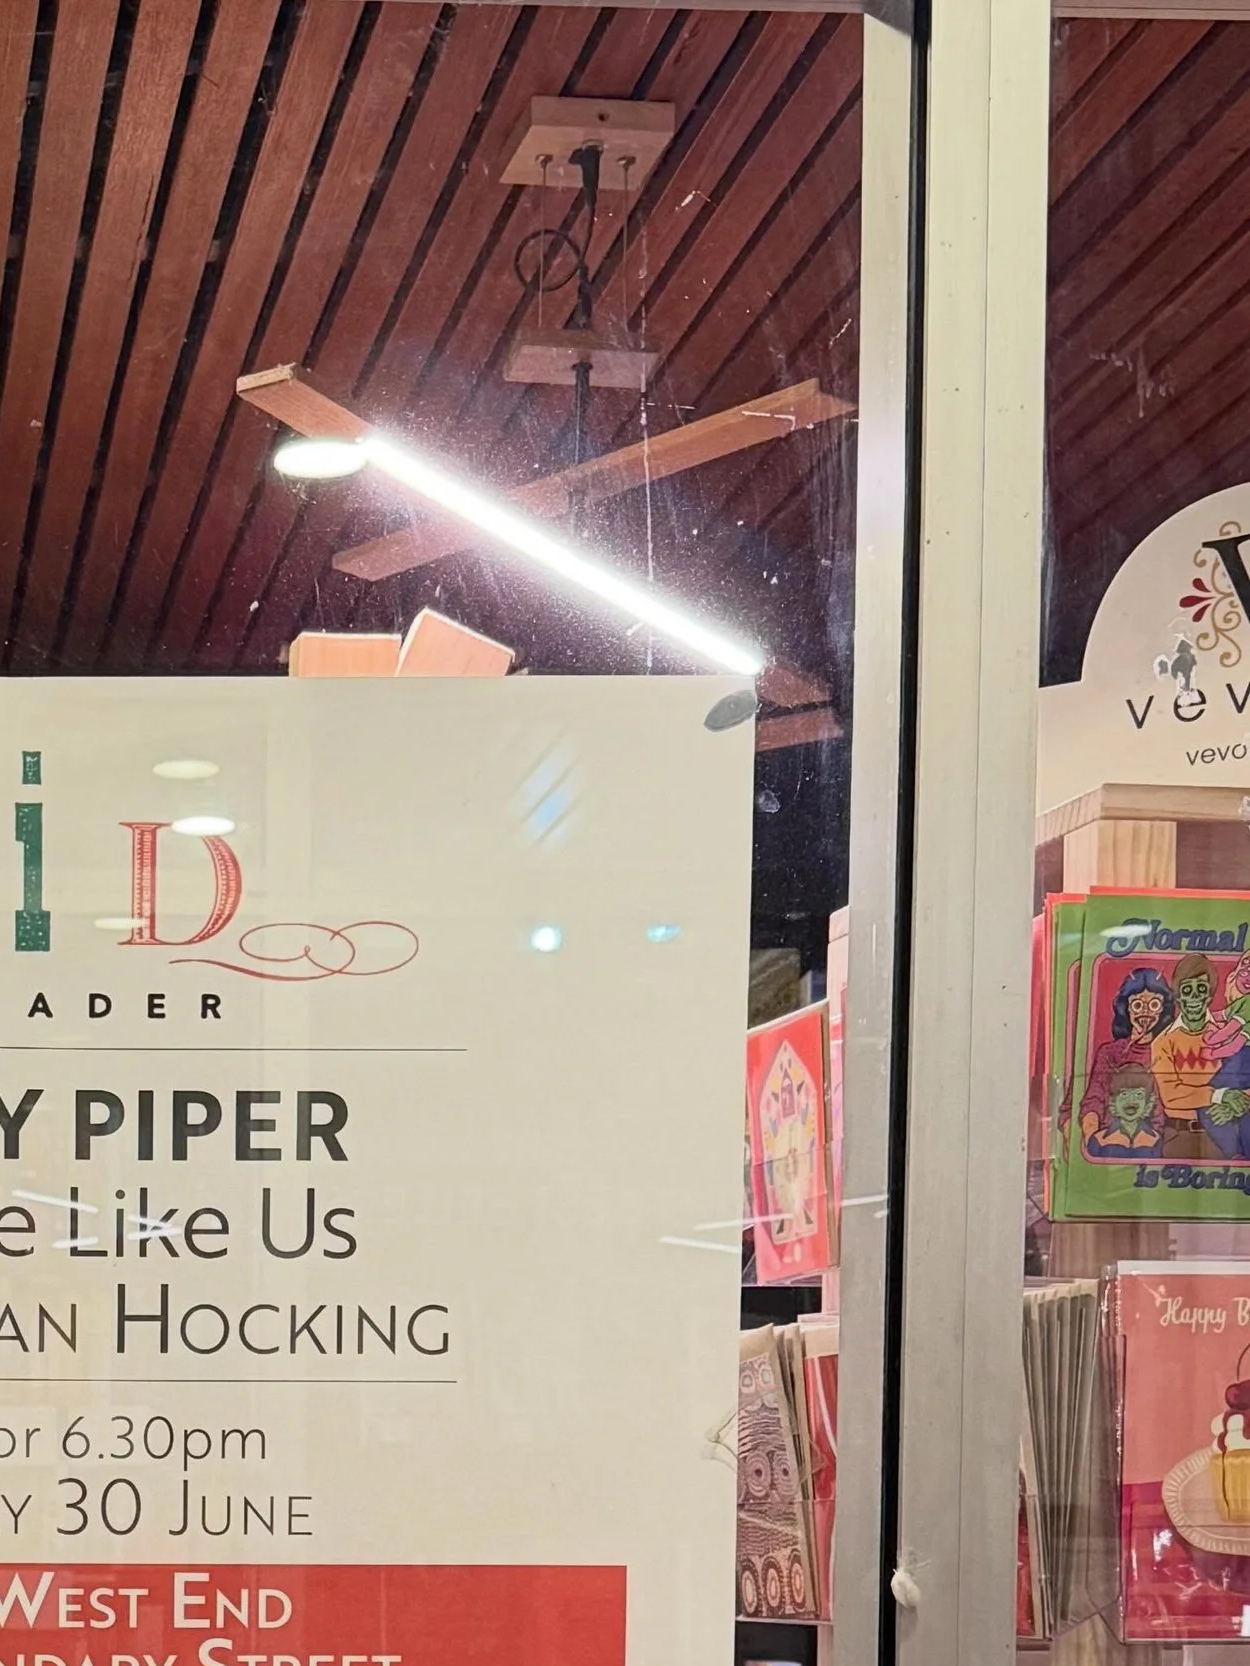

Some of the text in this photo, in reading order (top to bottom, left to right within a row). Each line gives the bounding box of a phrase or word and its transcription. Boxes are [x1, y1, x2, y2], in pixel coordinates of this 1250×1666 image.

[1106, 917, 1250, 958] Normal
[74, 1089, 349, 1162] PIPER
[1161, 1163, 1250, 1197] Borin
[69, 1186, 230, 1260] Like
[261, 1187, 358, 1260] Us
[1159, 1295, 1227, 1334] Happy
[61, 1415, 266, 1472] 6.30pm
[56, 1477, 142, 1536] 30
